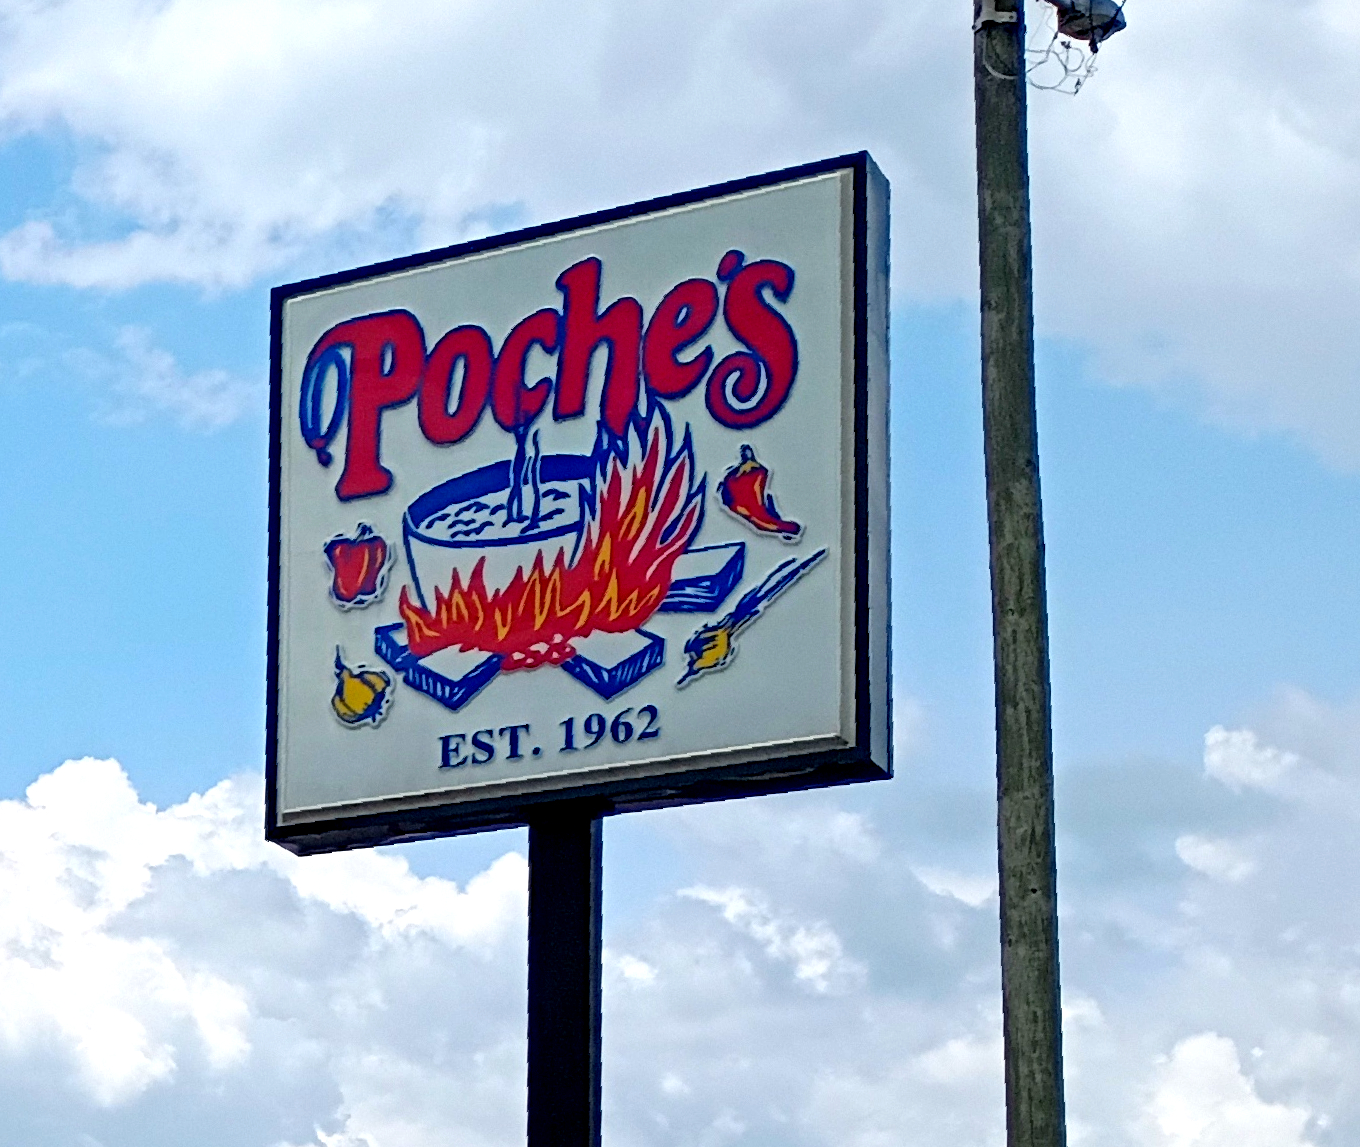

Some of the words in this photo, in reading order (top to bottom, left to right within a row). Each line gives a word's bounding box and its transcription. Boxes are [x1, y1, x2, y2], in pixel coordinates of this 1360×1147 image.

[299, 249, 799, 501] Poche's
[438, 723, 542, 769] EST.
[558, 704, 662, 752] 1962
